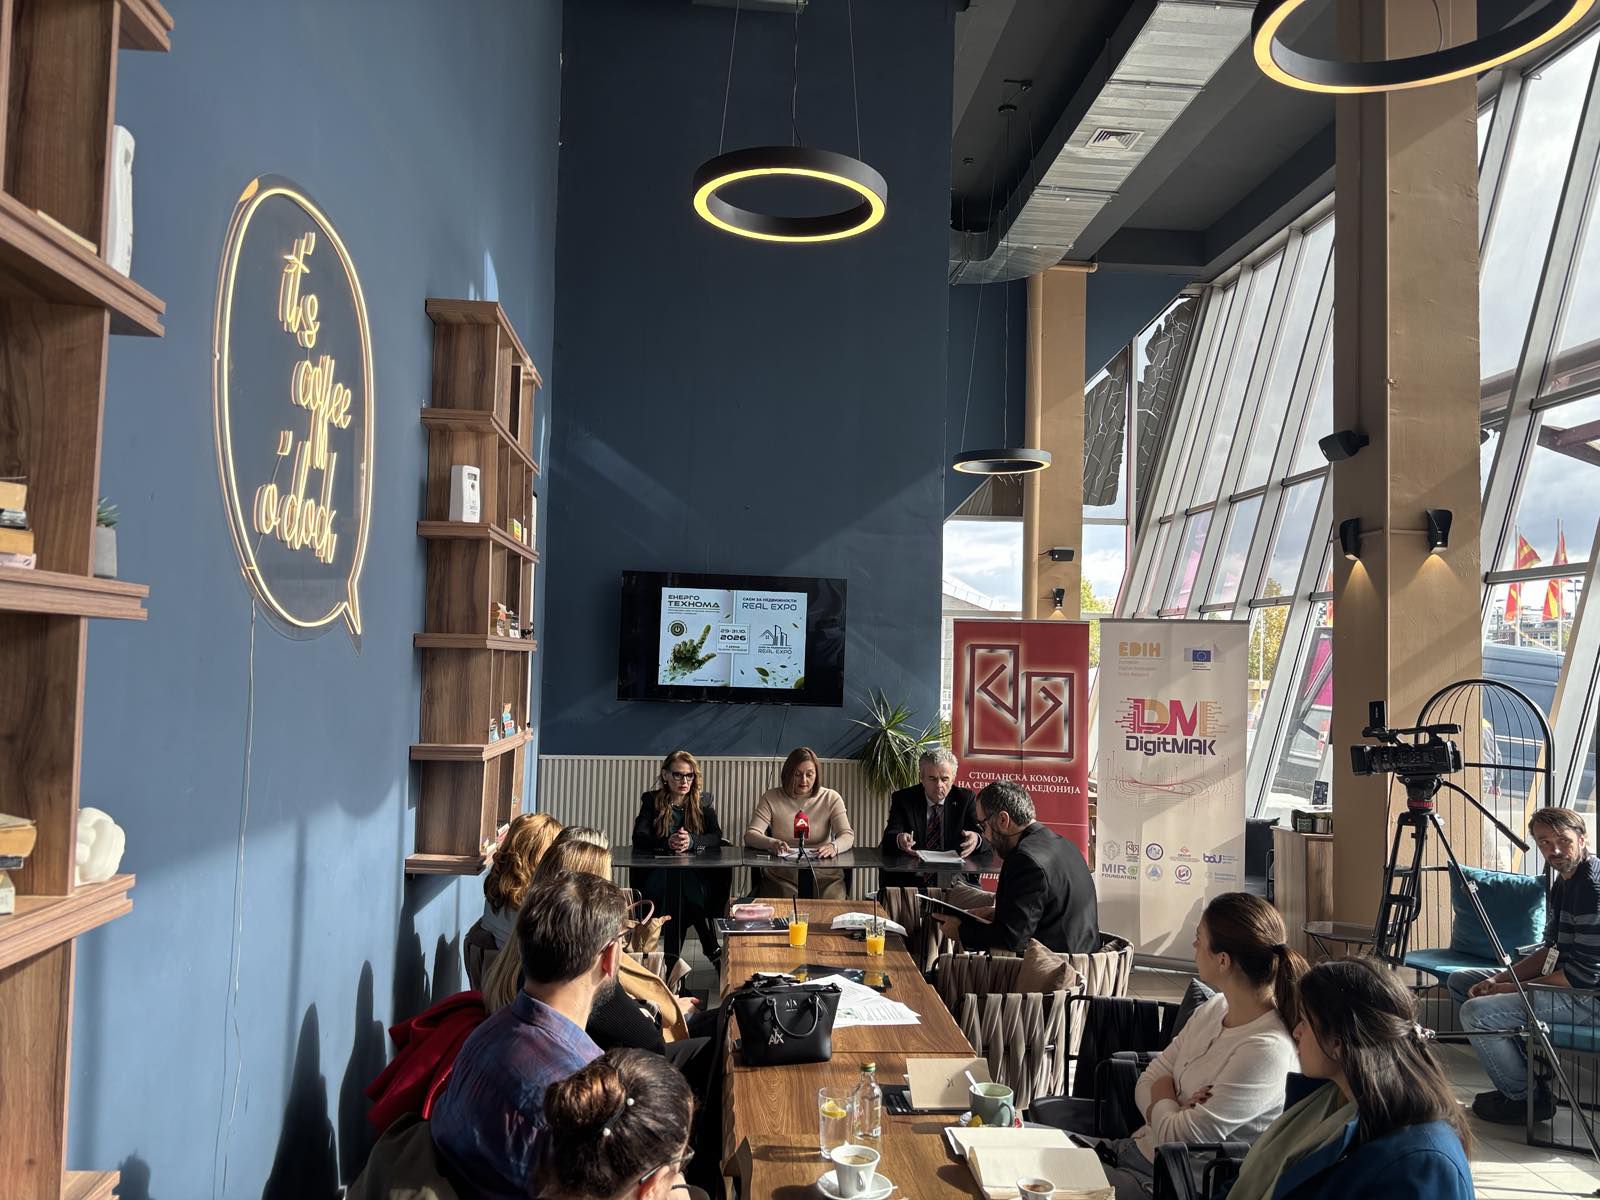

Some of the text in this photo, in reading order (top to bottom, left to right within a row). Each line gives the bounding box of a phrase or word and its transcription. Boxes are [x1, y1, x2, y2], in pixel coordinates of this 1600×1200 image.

[667, 600, 720, 608] ТЕХНОМА
[742, 602, 797, 611] REAL EXPO
[1118, 641, 1161, 657] EDIH
[1125, 735, 1217, 757] DigitMAK
[968, 771, 1070, 784] СТОПАНСКА КОМОРА
[958, 780, 972, 789] НА
